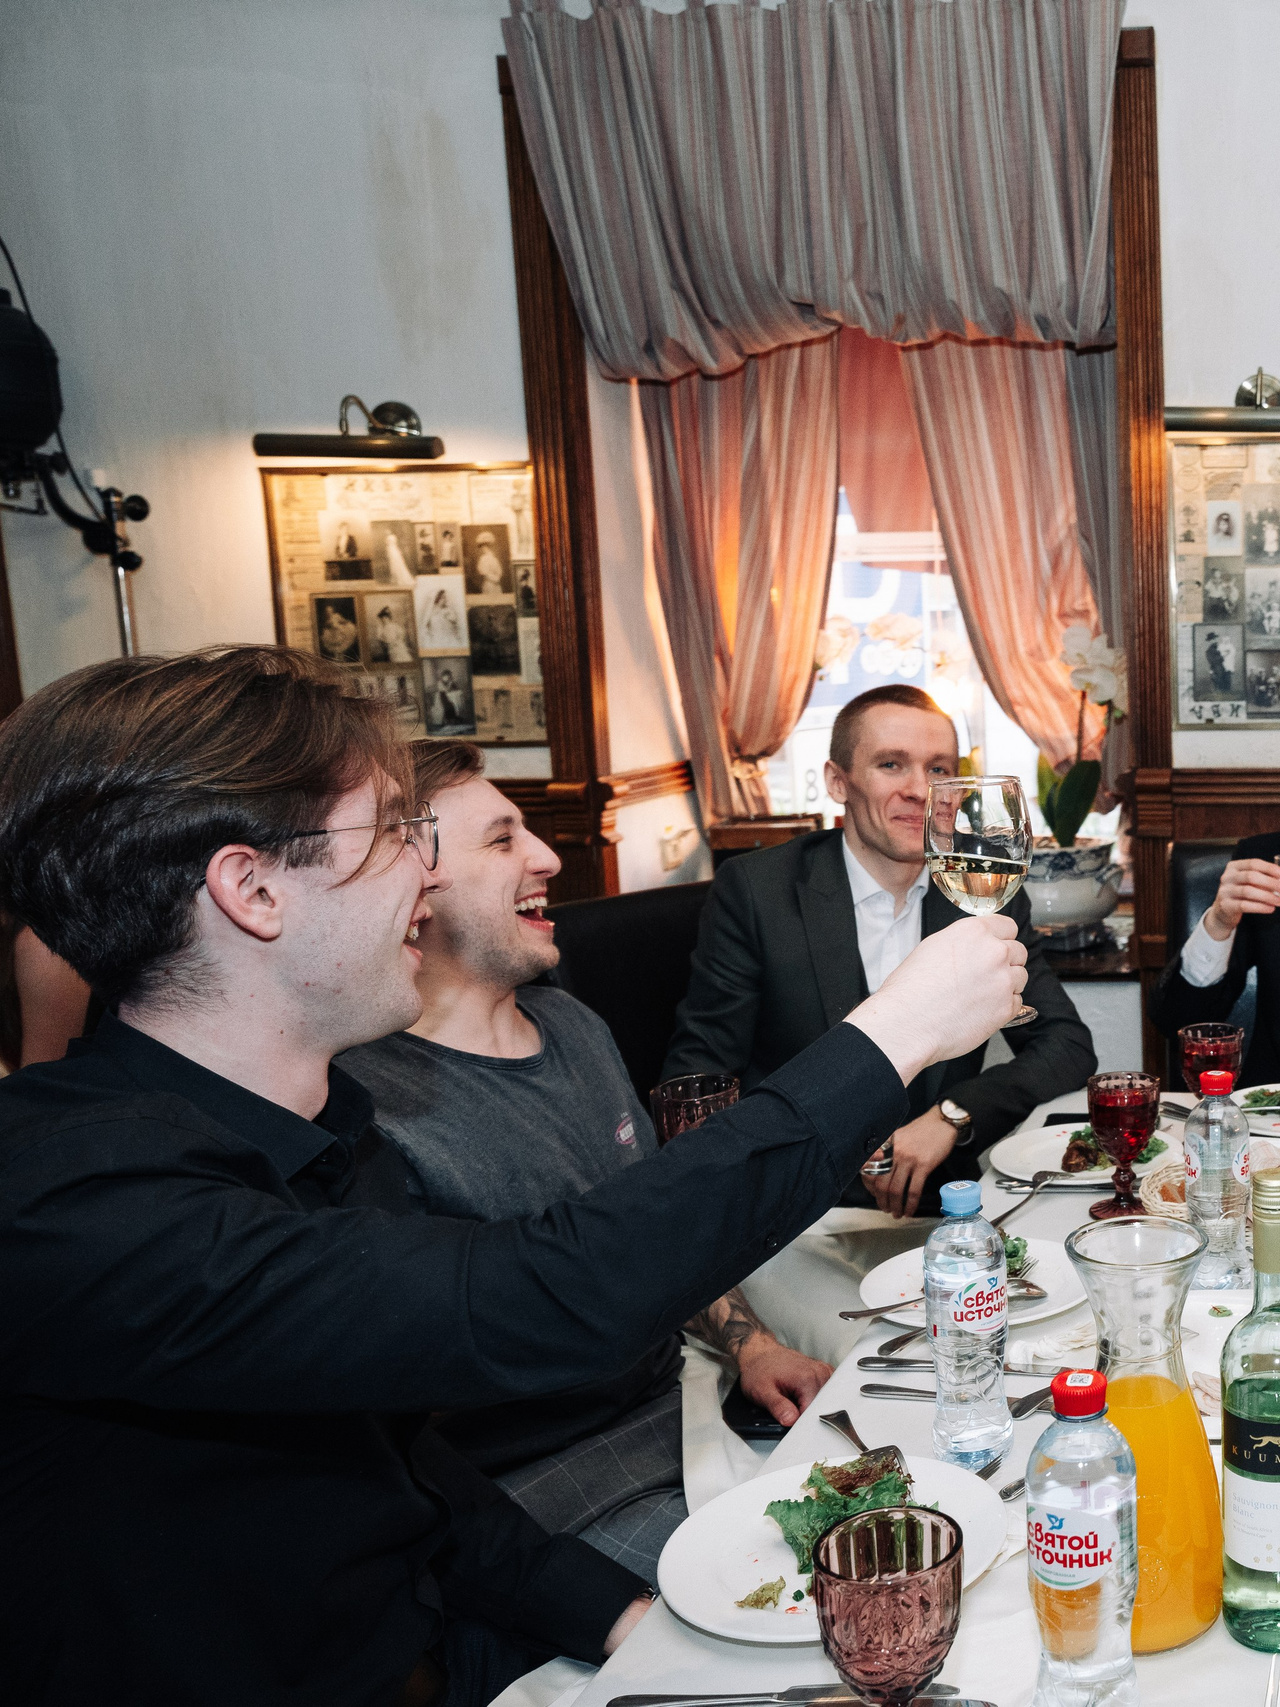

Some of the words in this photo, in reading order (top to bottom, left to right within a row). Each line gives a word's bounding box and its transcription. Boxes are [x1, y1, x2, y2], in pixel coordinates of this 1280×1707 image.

[964, 1284, 1007, 1309] свято
[954, 1299, 1007, 1322] источн
[1232, 1492, 1278, 1510] Sauvignon
[1232, 1503, 1255, 1519] Blanc
[1028, 1539, 1112, 1568] сточник
